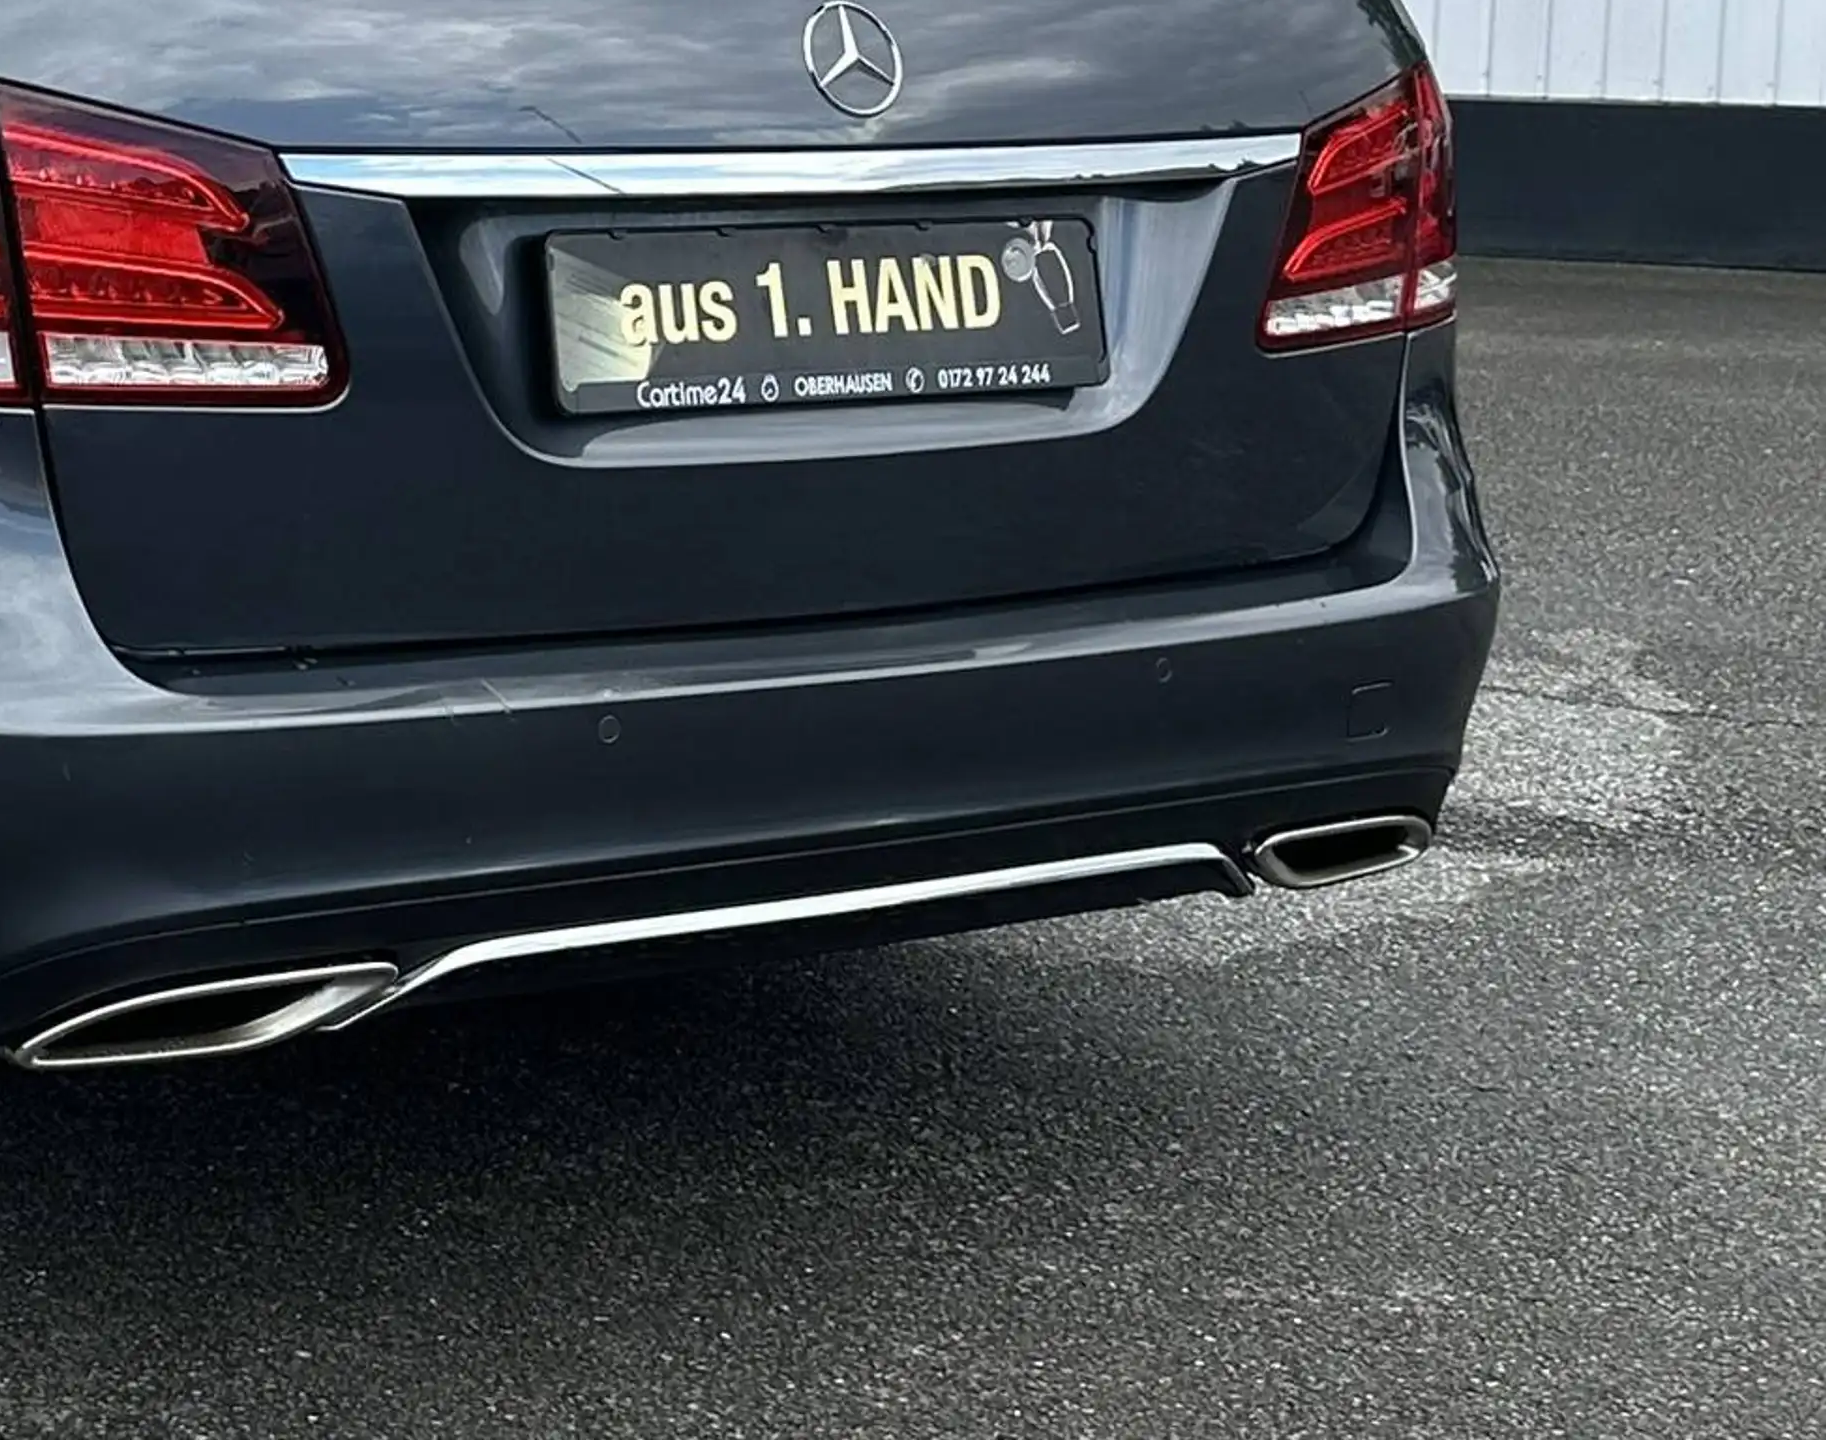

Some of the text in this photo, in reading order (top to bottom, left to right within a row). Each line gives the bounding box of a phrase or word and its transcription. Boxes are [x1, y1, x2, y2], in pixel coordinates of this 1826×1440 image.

[618, 253, 1002, 348] aus 1. HAND
[793, 372, 893, 397] OBERHAUSEN
[937, 363, 1051, 389] 0172 97 24 244
[637, 375, 746, 408] Cartime24
